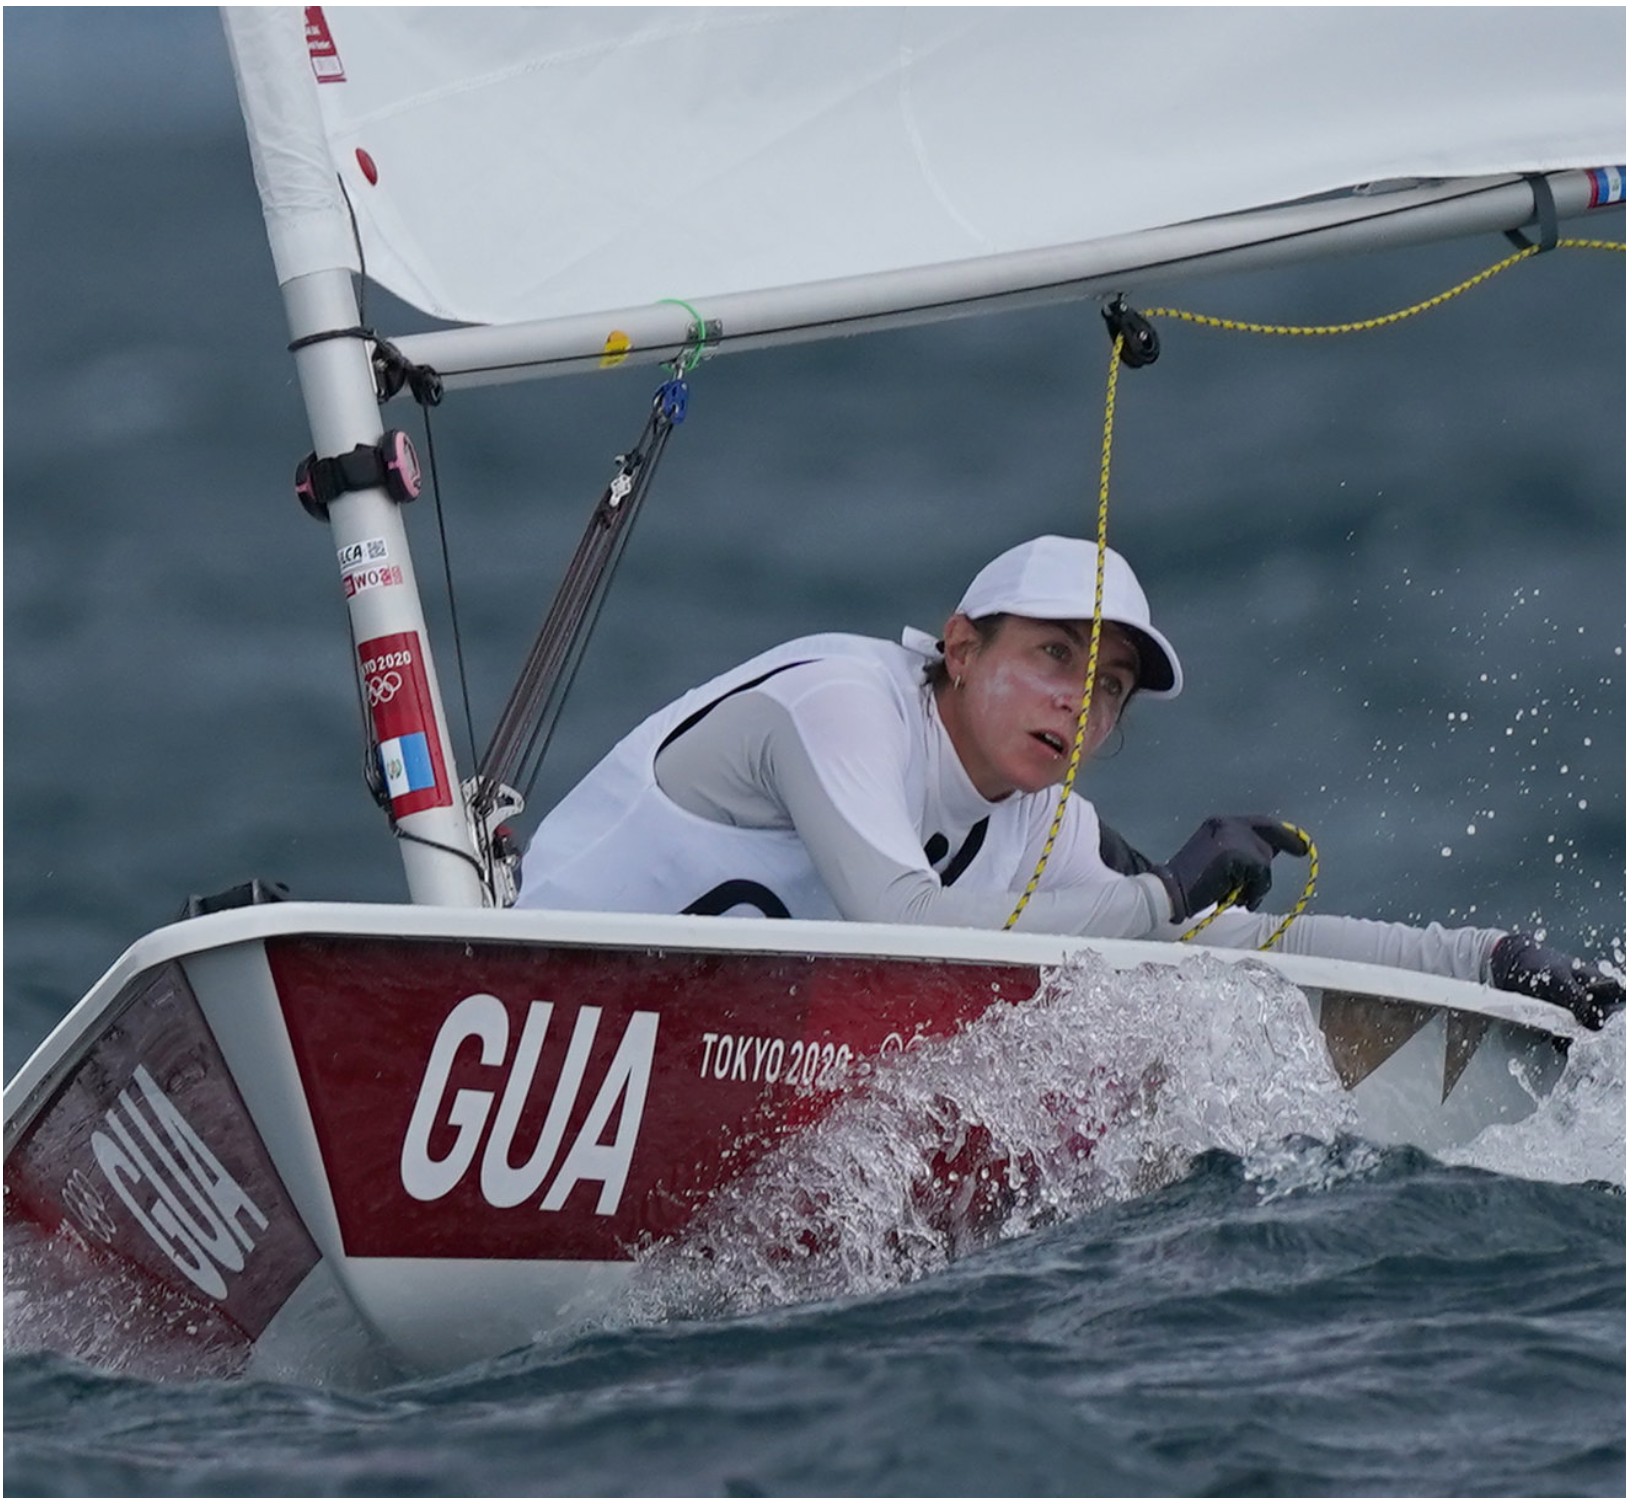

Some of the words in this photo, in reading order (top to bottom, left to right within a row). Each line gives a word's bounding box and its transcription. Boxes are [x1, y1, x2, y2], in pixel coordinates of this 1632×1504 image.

[376, 650, 412, 671] 2020
[400, 993, 660, 1216] GUA
[700, 1032, 785, 1084] TOKYO
[90, 1063, 269, 1300] GUA
